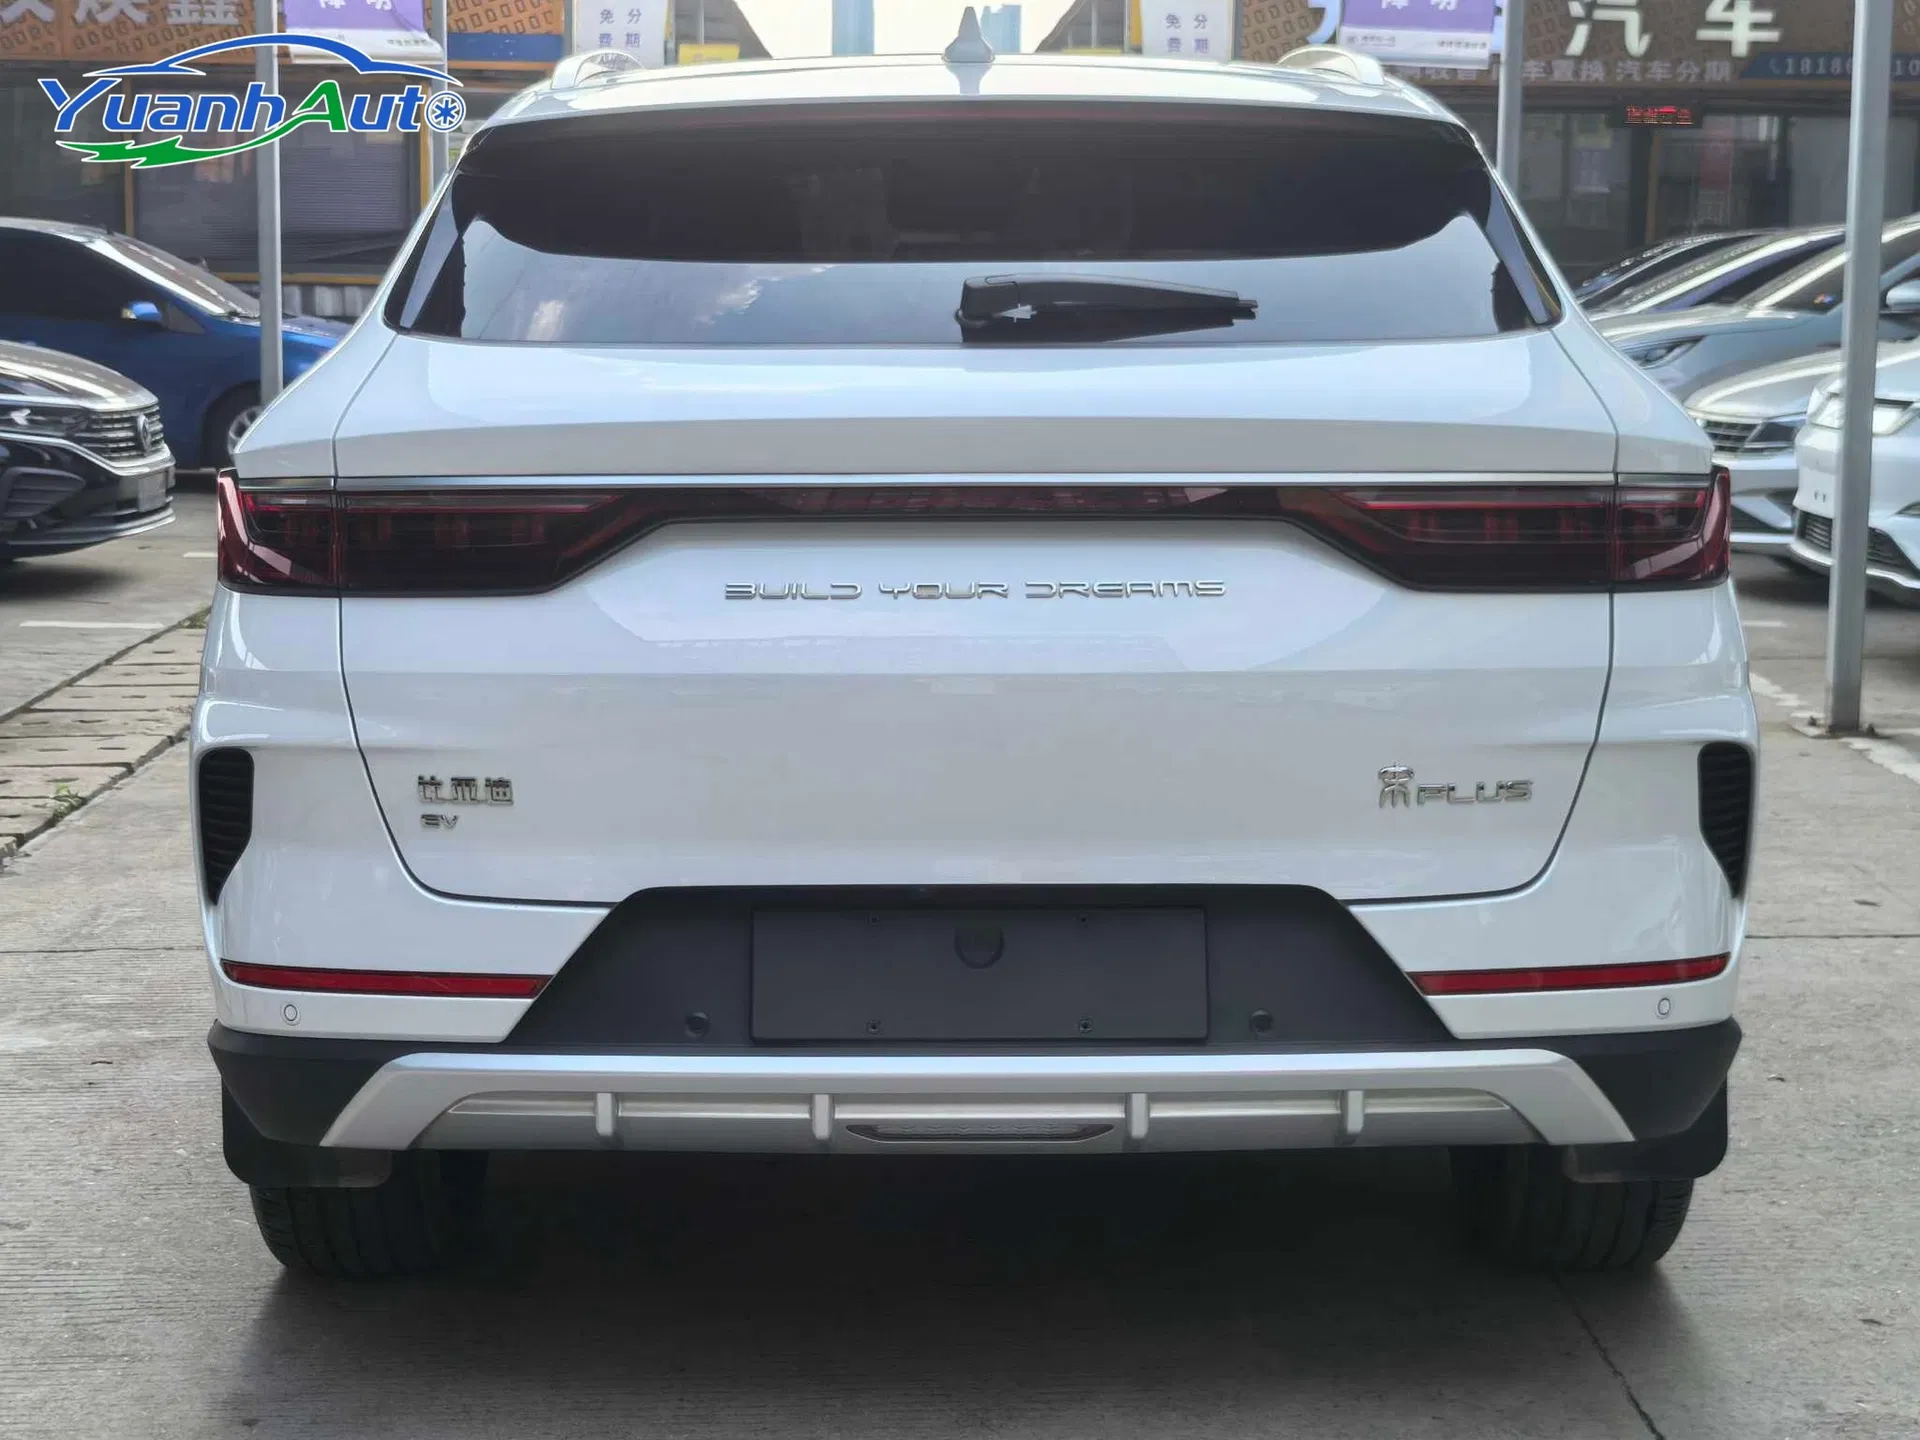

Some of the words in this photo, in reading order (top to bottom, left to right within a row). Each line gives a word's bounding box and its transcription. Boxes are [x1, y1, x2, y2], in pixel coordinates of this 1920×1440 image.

[1492, 59, 1606, 82] 车置换
[1616, 59, 1732, 82] 汽车分期
[725, 582, 862, 600] BUILD
[878, 580, 1009, 600] YOUR
[1025, 579, 1226, 599] DREAMS
[417, 775, 514, 805] 比亚迪
[420, 813, 459, 829] EV
